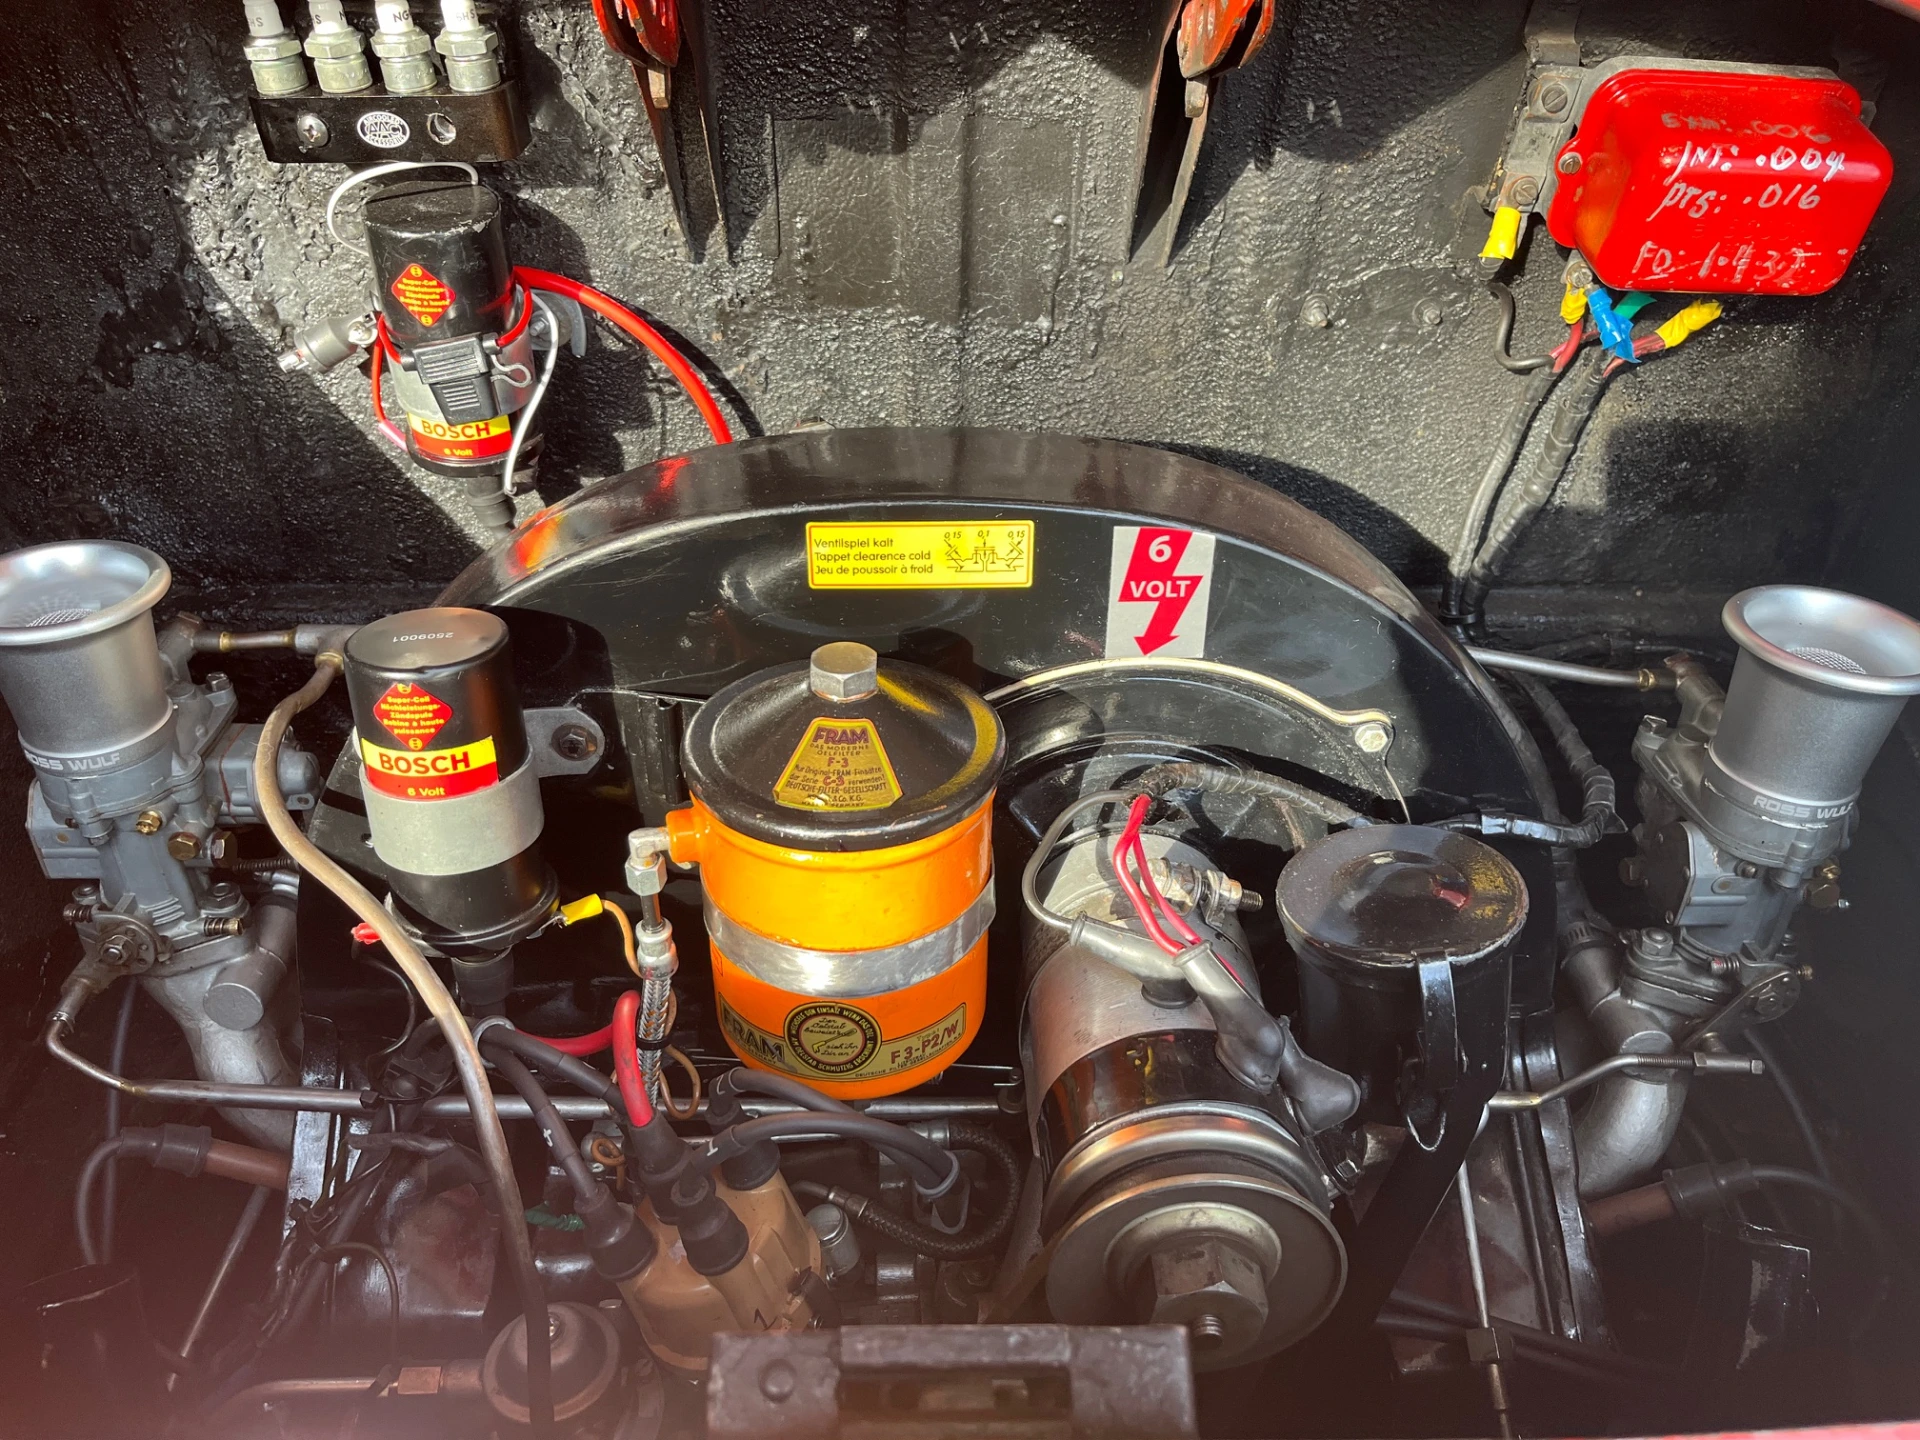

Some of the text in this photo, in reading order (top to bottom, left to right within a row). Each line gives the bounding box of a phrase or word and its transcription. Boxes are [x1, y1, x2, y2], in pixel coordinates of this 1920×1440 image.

[421, 420, 491, 439] BOSCH
[452, 448, 473, 456] Volt
[814, 538, 894, 549] Ventilspiel kalt
[1148, 535, 1172, 563] 6
[815, 550, 931, 563] Tappet clearence cold
[815, 564, 933, 576] Jeu de poussoir à froid
[1129, 580, 1191, 598] VOLT
[812, 726, 869, 745] FRAM
[67, 752, 120, 771] WULF
[379, 751, 470, 775] BOSCH
[827, 756, 849, 768] F-3
[407, 787, 446, 796] 6 Volt
[1753, 794, 1811, 818] ROSS
